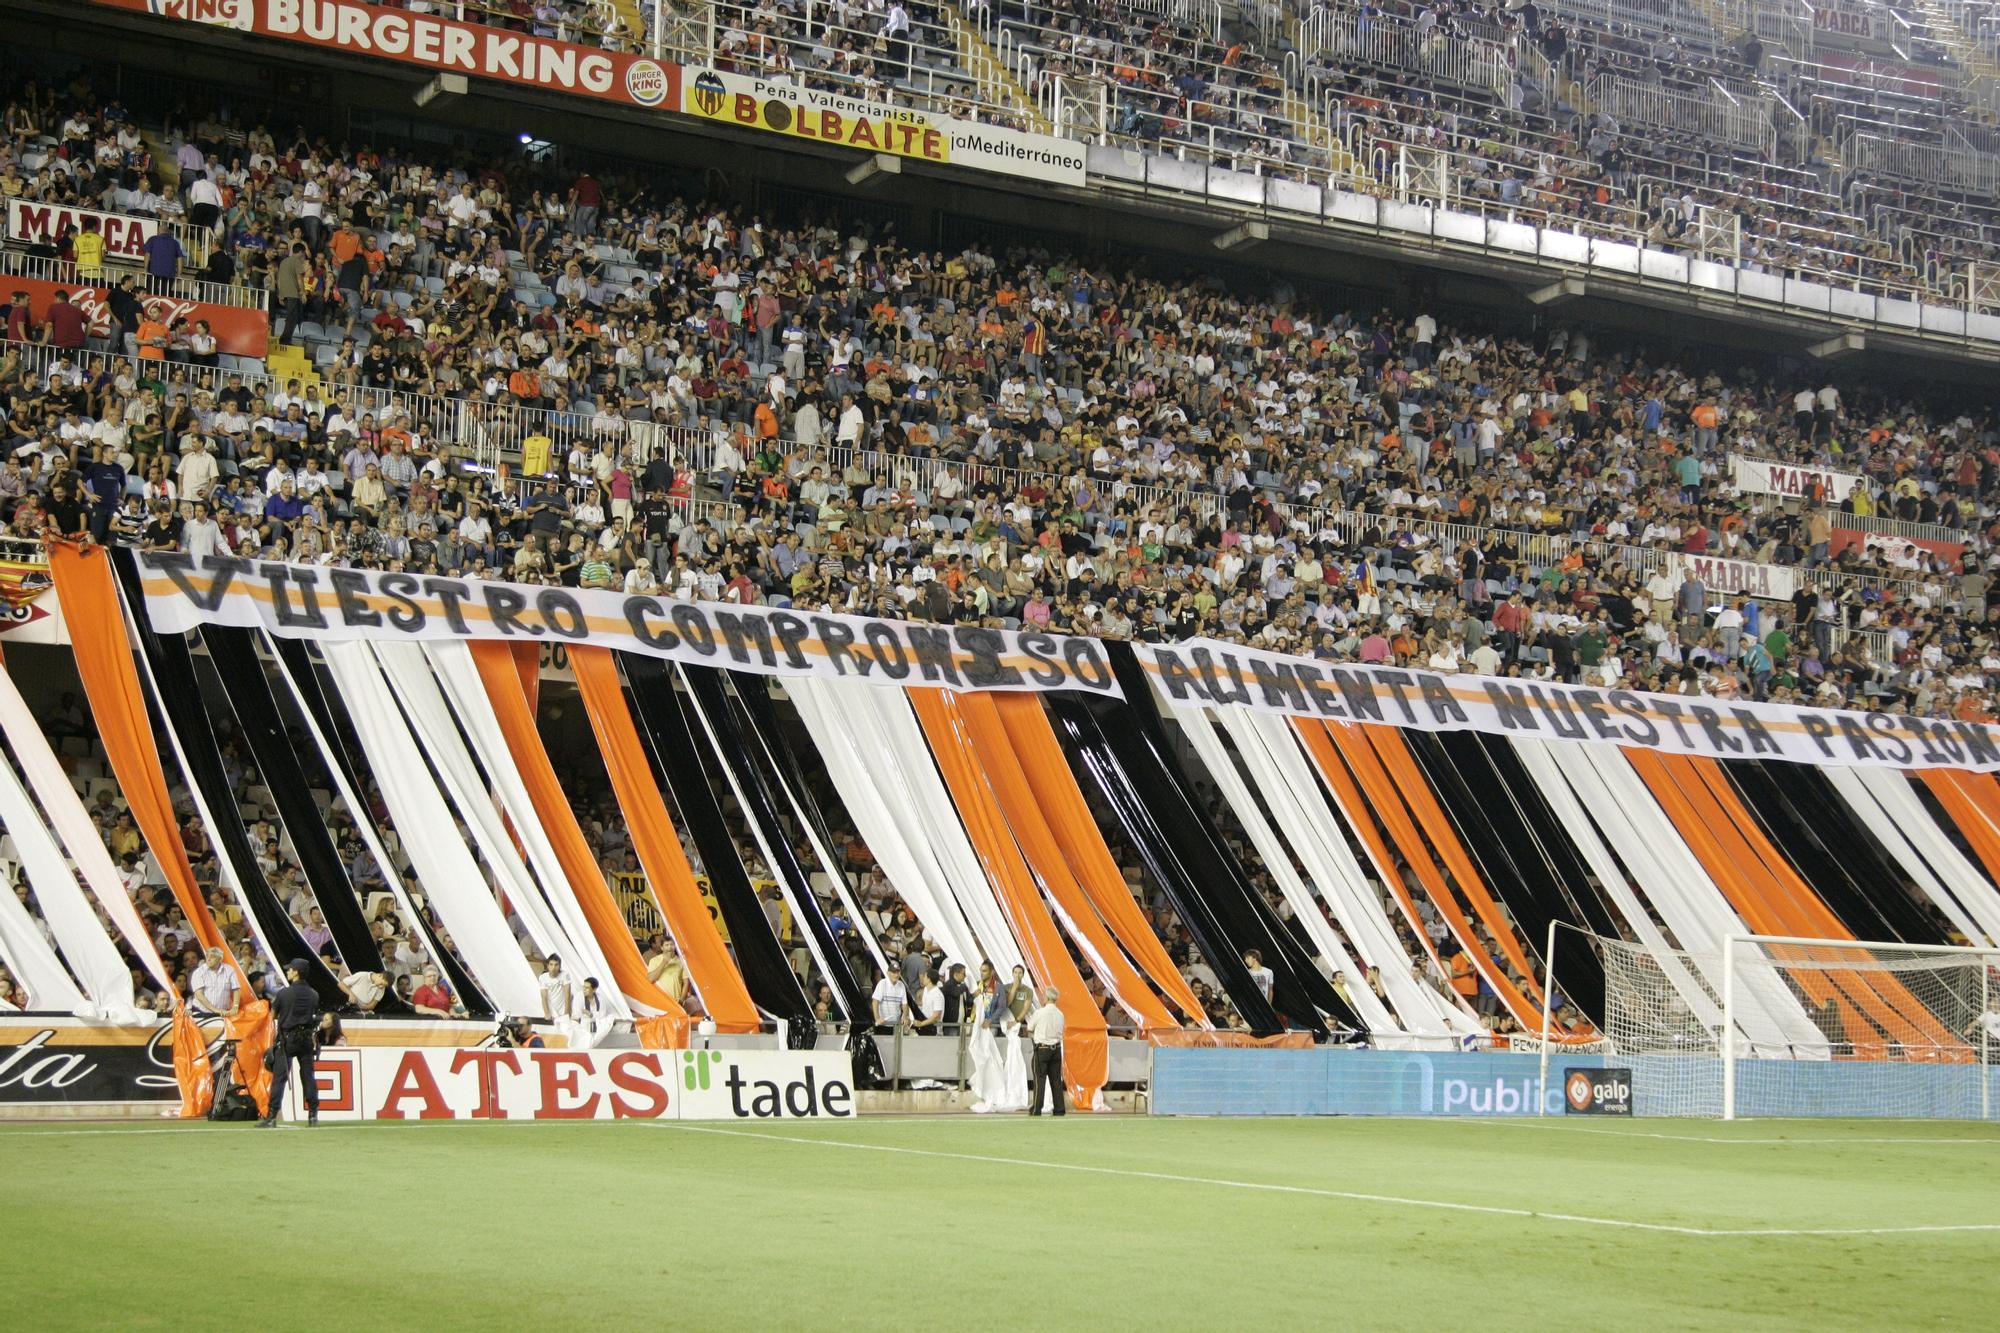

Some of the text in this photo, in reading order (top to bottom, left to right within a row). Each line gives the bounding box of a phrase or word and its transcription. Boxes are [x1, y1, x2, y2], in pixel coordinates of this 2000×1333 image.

[1814, 8, 1871, 37] MARCA
[268, 0, 614, 93] BURGER KING
[631, 71, 661, 81] BURGER
[632, 80, 662, 91] KING
[754, 82, 926, 125] Peña Valencianista
[951, 131, 1083, 170] jaMediterráneo
[1695, 558, 1770, 596] MARCA
[139, 550, 589, 639] VUESTRO
[1482, 681, 1785, 755] NUESTRA
[1512, 1039, 1543, 1052] PENY
[376, 1048, 670, 1119] ATES
[725, 1064, 851, 1118] tade
[1593, 1079, 1629, 1104] galp
